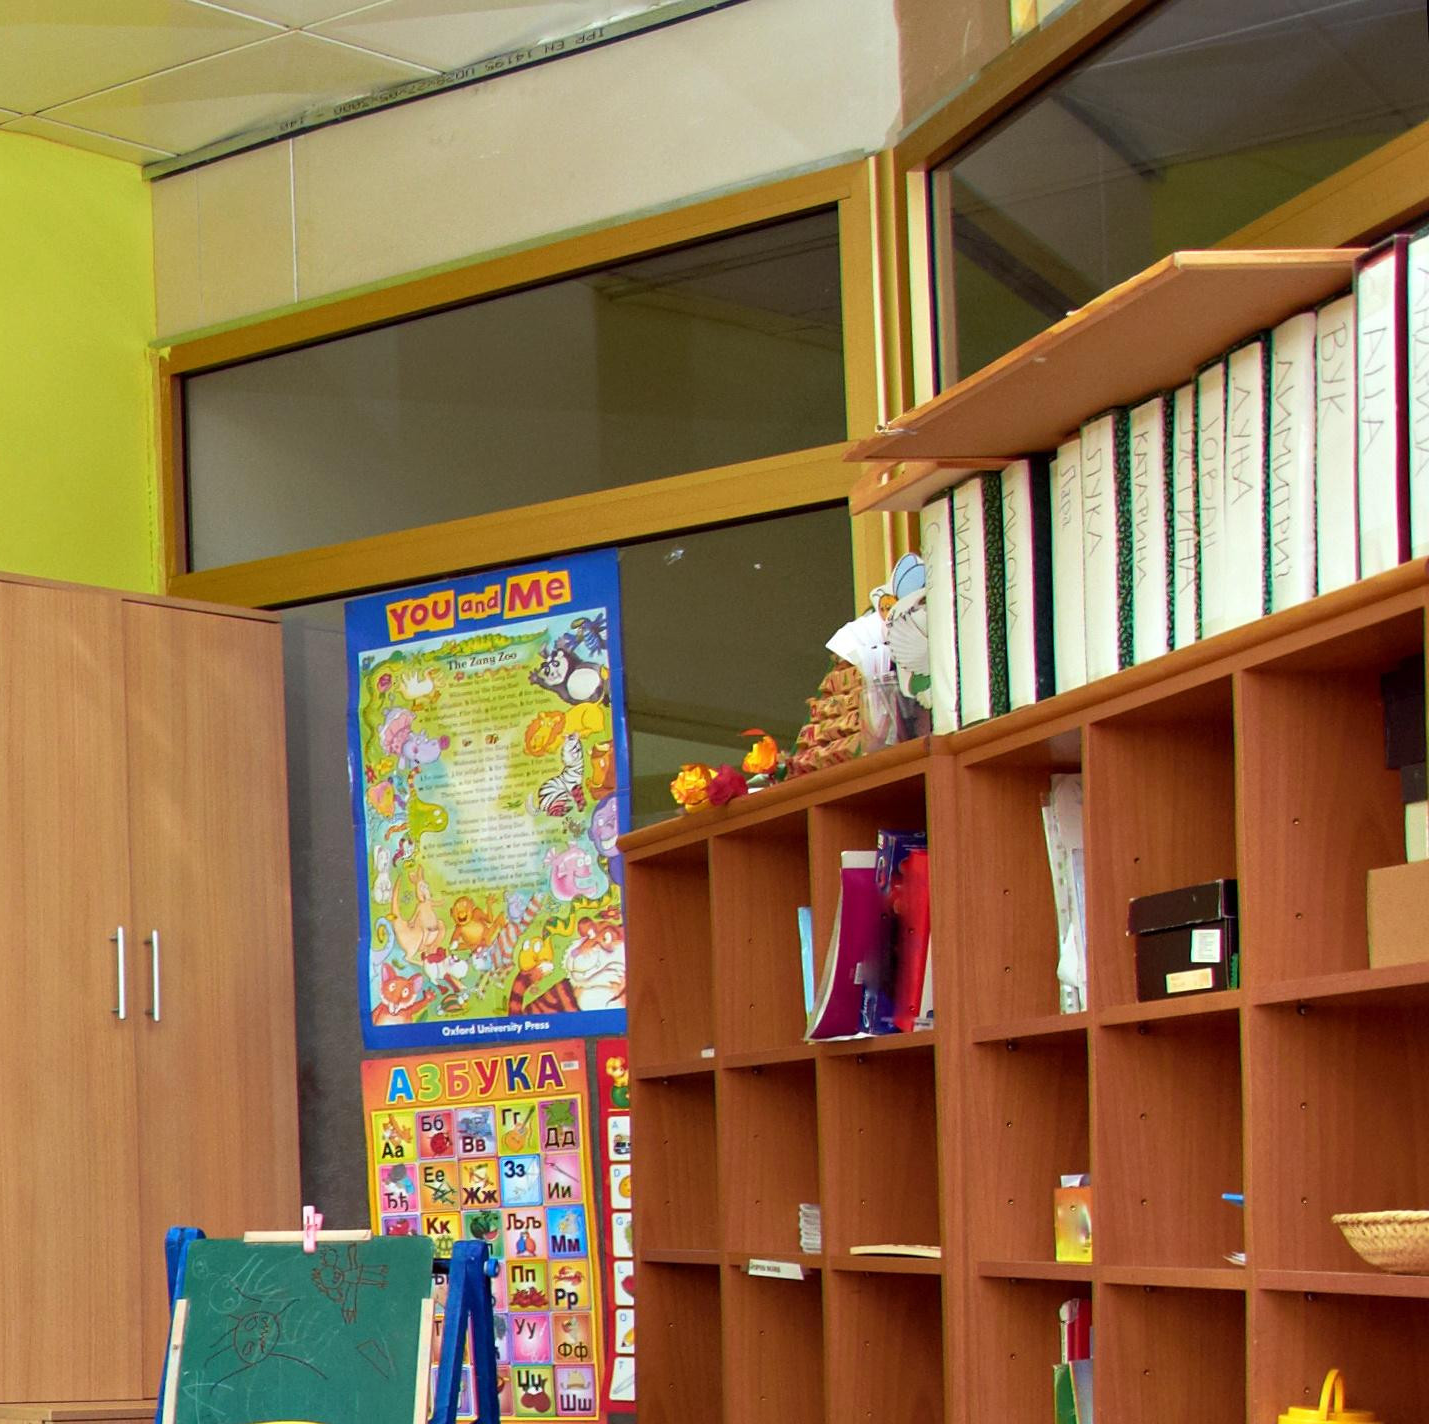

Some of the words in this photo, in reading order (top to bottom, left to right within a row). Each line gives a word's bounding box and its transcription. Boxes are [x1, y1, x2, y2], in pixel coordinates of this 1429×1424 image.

[1320, 321, 1347, 432] ВУК
[1362, 327, 1387, 456] АЦА
[1085, 447, 1103, 558] ЛУКА
[1134, 431, 1149, 589] КАТАРИНА
[955, 504, 973, 620] МИТРА
[460, 591, 499, 614] and
[509, 578, 565, 612] Me
[447, 659, 467, 670] The
[498, 651, 518, 662] Zoo
[442, 1024, 475, 1037] Oxford
[477, 1022, 522, 1034] University
[524, 1020, 550, 1031] Press
[386, 1051, 566, 1104] АЗБУКА
[421, 1116, 444, 1132] Бб
[501, 1109, 520, 1125] Гг
[382, 1143, 404, 1159] Аа
[462, 1136, 486, 1153] Вв
[425, 1166, 445, 1183] Ее
[504, 1161, 526, 1178] Зз
[463, 1187, 497, 1205] Жж
[548, 1183, 571, 1199] Ии
[426, 1217, 450, 1234] Кк
[507, 1214, 542, 1230] Љљ
[552, 1235, 580, 1253] Мм
[511, 1265, 536, 1282] Пп
[555, 1289, 578, 1309] Рр
[515, 1319, 536, 1339] Уу
[558, 1342, 588, 1362] Фф
[561, 1394, 591, 1411] Шш
